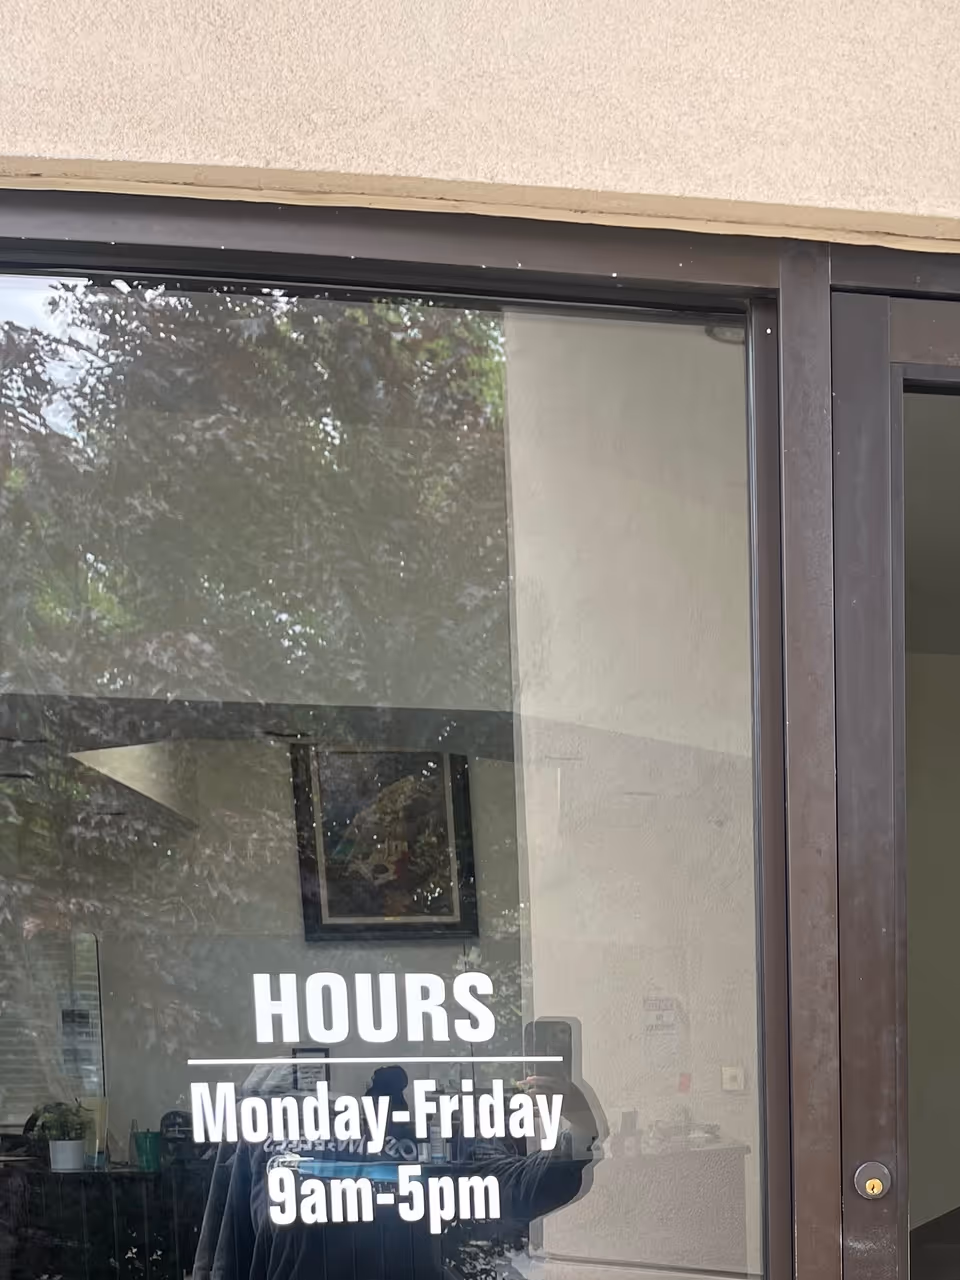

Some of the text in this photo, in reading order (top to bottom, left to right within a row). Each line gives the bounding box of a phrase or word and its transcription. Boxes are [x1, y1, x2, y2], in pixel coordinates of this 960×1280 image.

[252, 972, 496, 1043] HOURS
[190, 1079, 564, 1155] Monday-Friday
[267, 1164, 501, 1235] 9am-5pm
